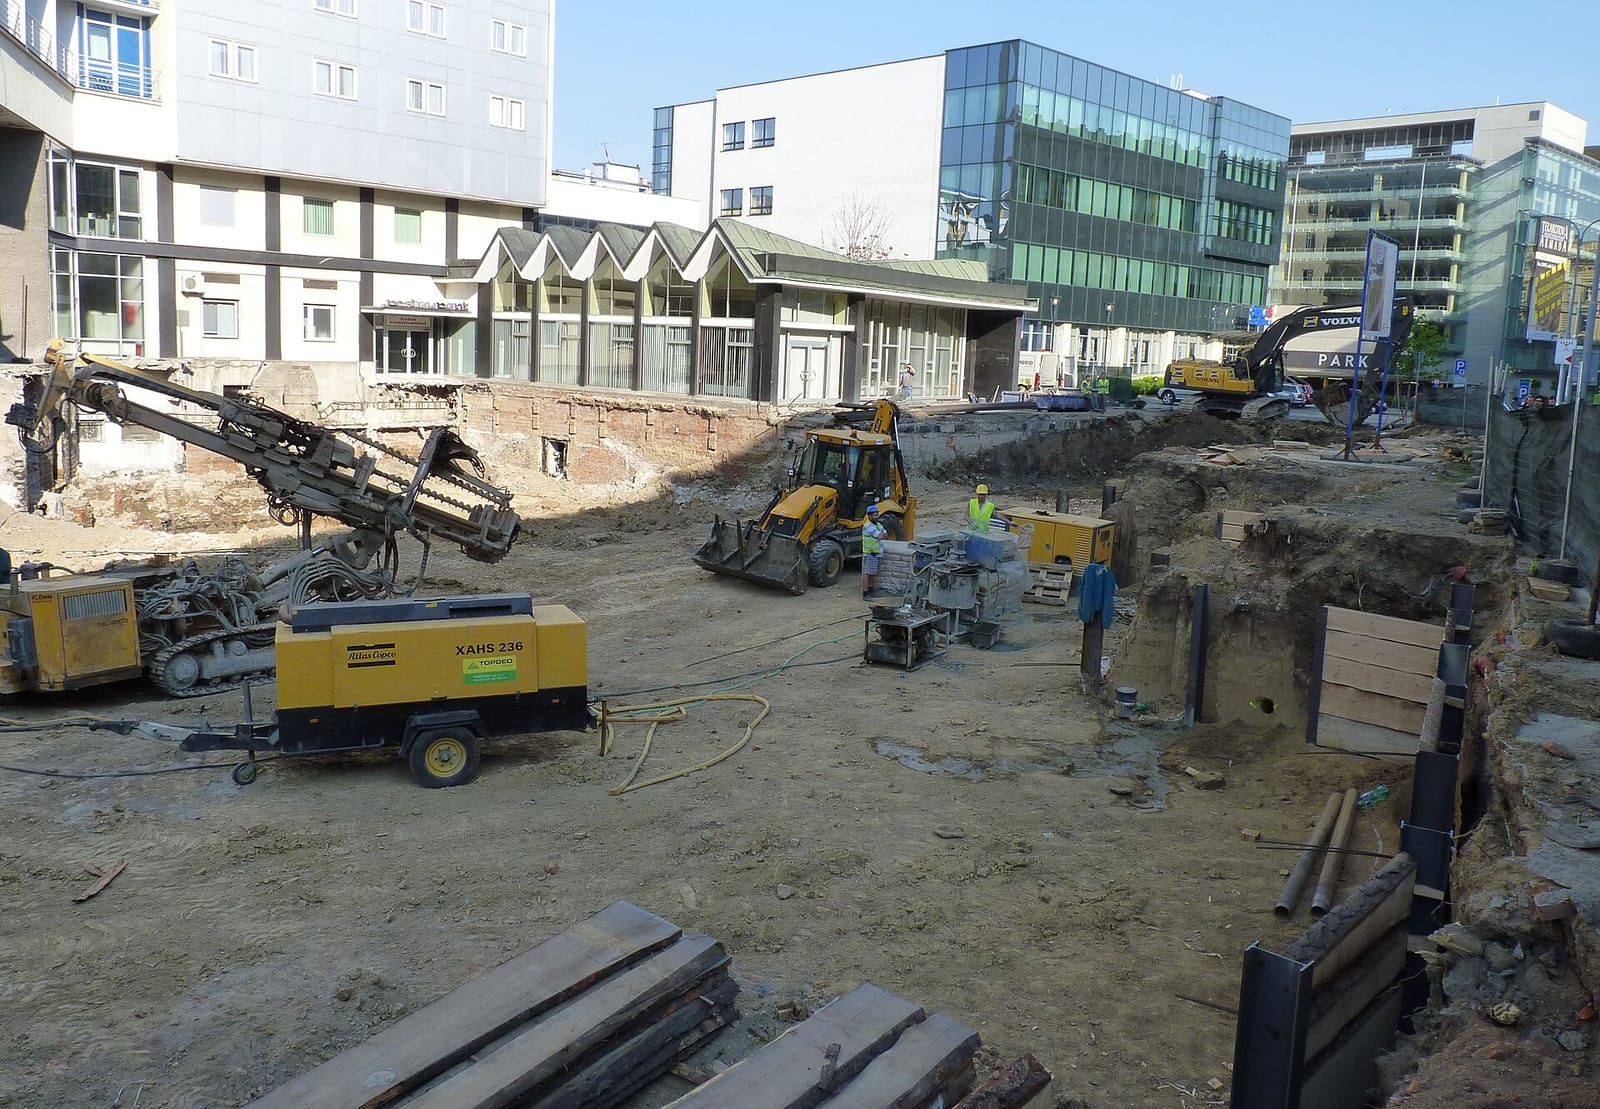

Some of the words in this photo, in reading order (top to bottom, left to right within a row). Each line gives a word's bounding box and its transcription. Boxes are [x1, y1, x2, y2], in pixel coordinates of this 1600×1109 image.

[1318, 353, 1368, 368] PARK
[455, 643, 495, 656] XAHS
[499, 641, 523, 653] 236
[348, 652, 371, 660] Atlas
[372, 651, 397, 660] Copco
[479, 658, 513, 666] TOPGEO
